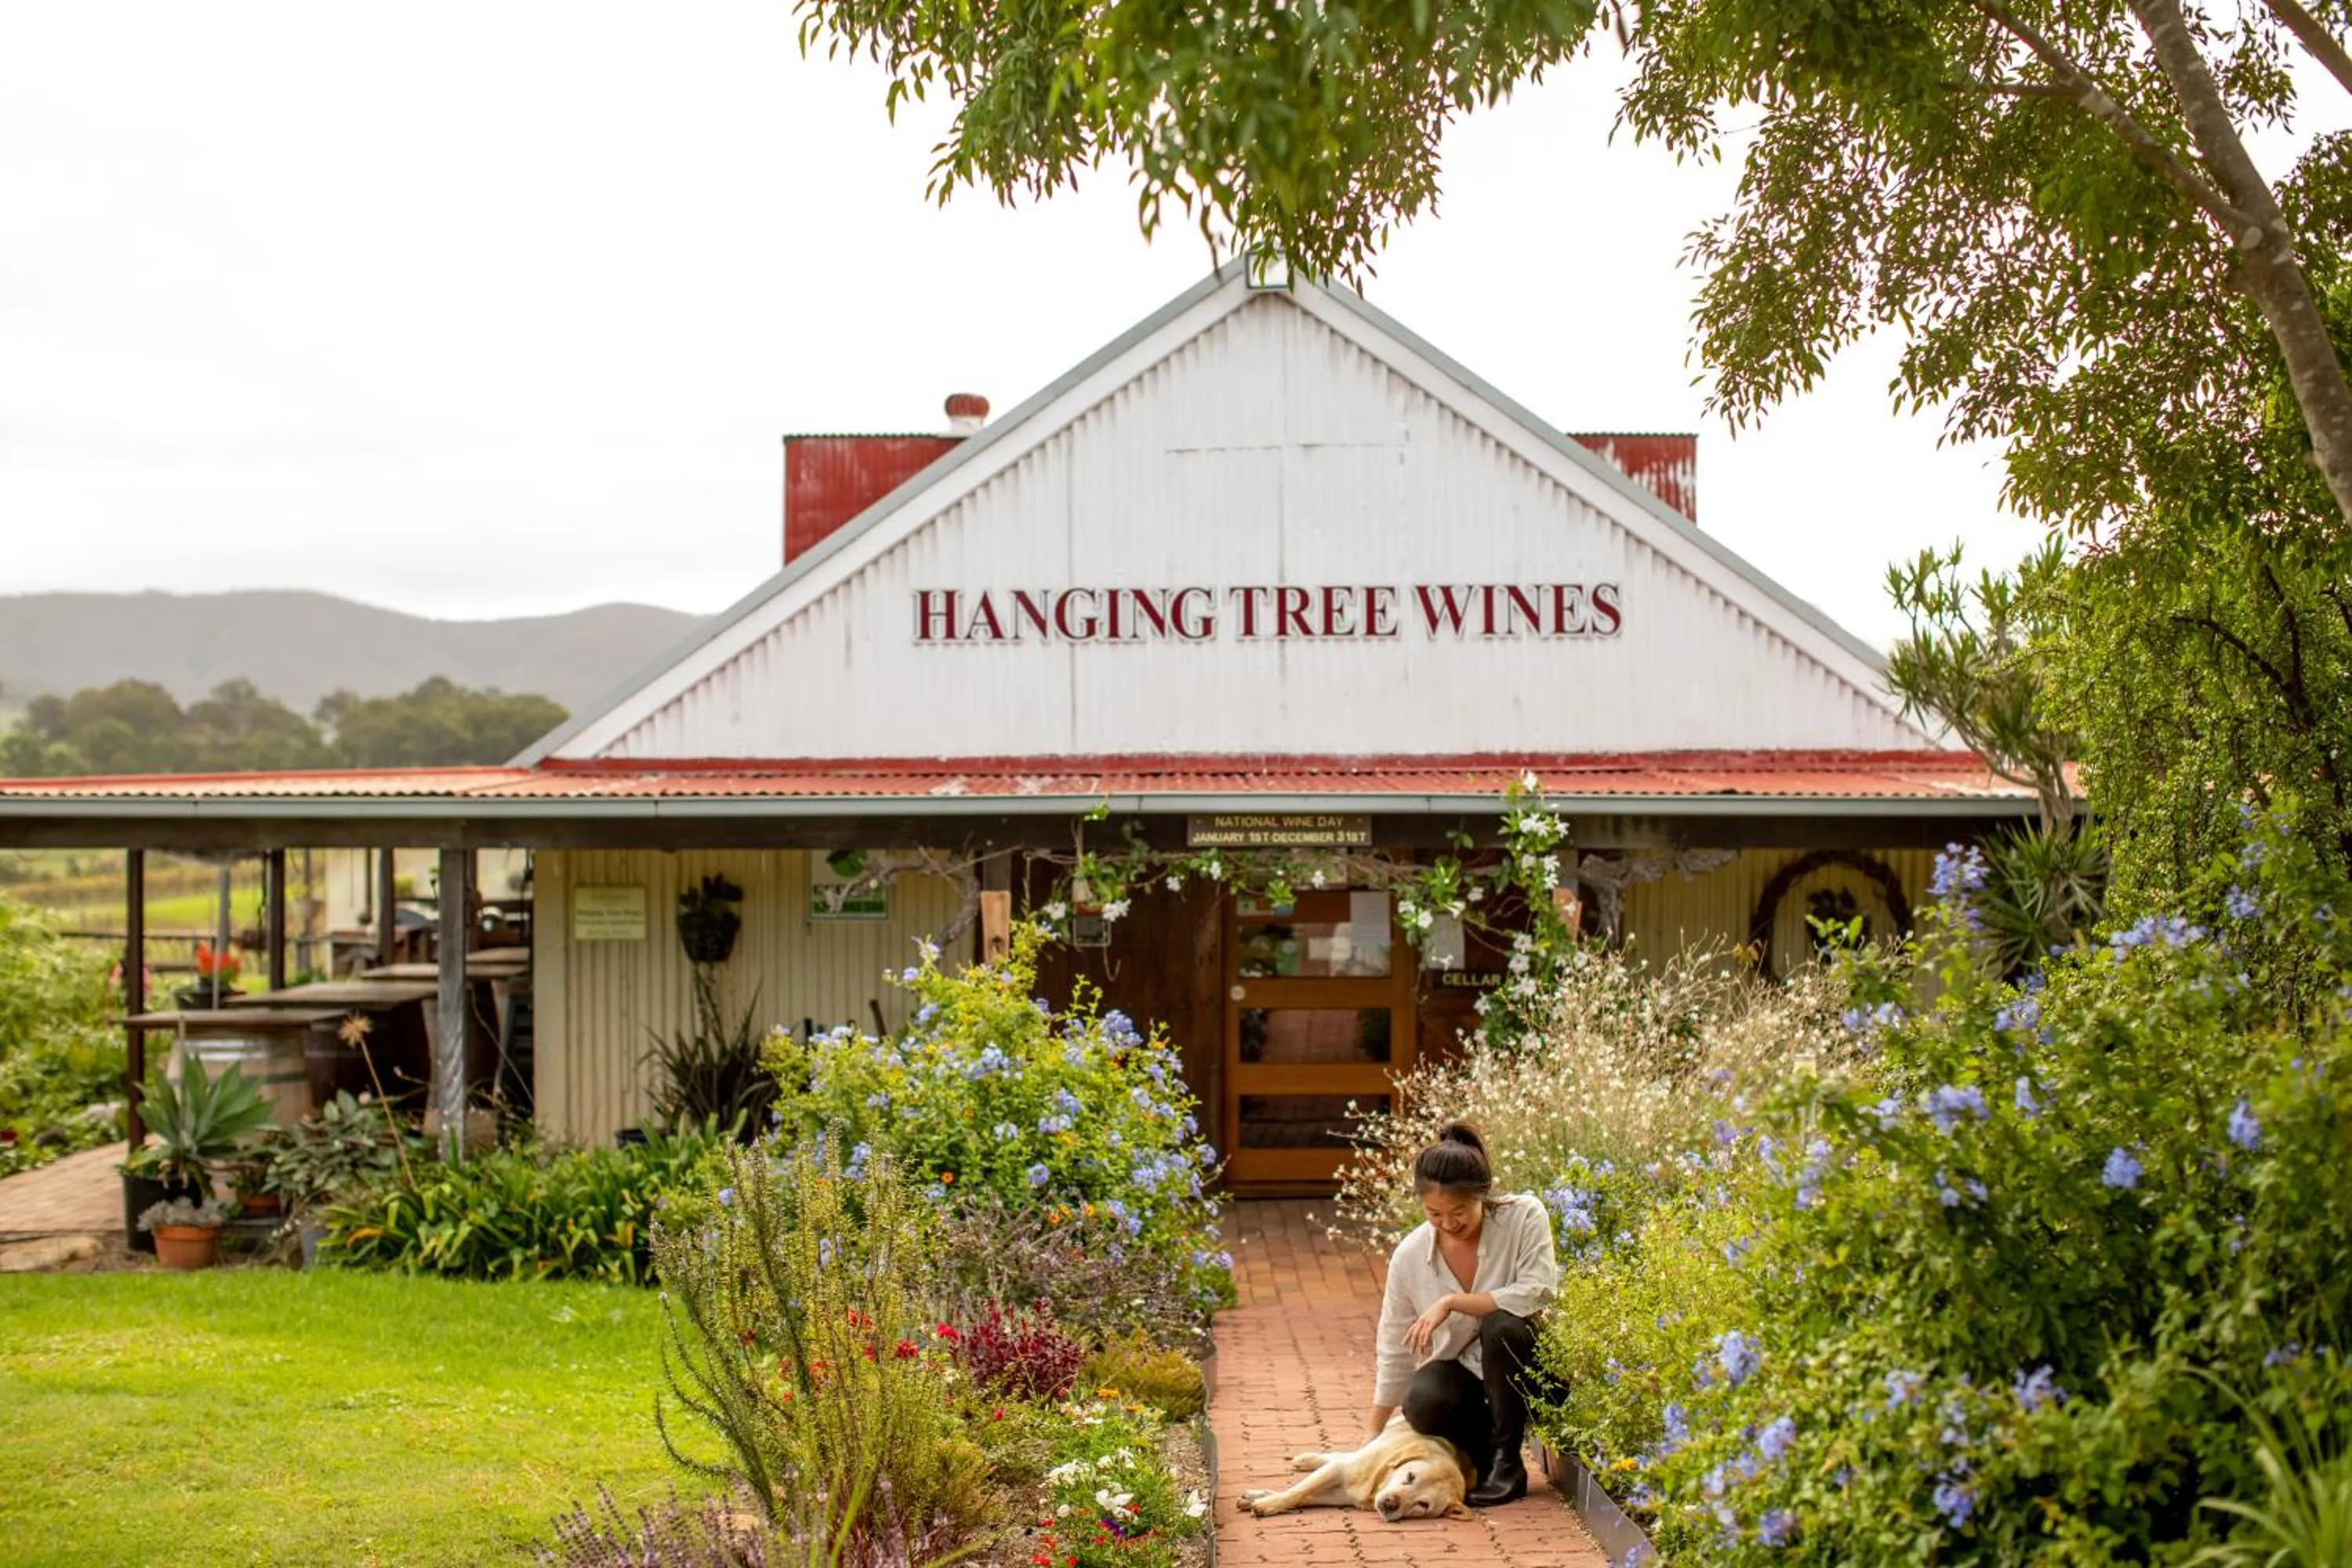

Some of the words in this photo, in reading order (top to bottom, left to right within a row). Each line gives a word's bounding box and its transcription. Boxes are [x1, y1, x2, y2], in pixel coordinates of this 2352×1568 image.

[915, 586, 1214, 643] HANGING
[1229, 586, 1399, 640] TREE
[1414, 583, 1622, 637] WINES
[1214, 815, 1279, 828] NATIONAL
[1282, 815, 1315, 827] WINE
[1317, 815, 1344, 828] DAY
[1192, 831, 1245, 843] JANUARY
[1249, 831, 1269, 843] 1ST
[1271, 831, 1334, 843] DECEMBER
[1336, 830, 1367, 843] 31ST
[1442, 973, 1501, 986] CELLAR
